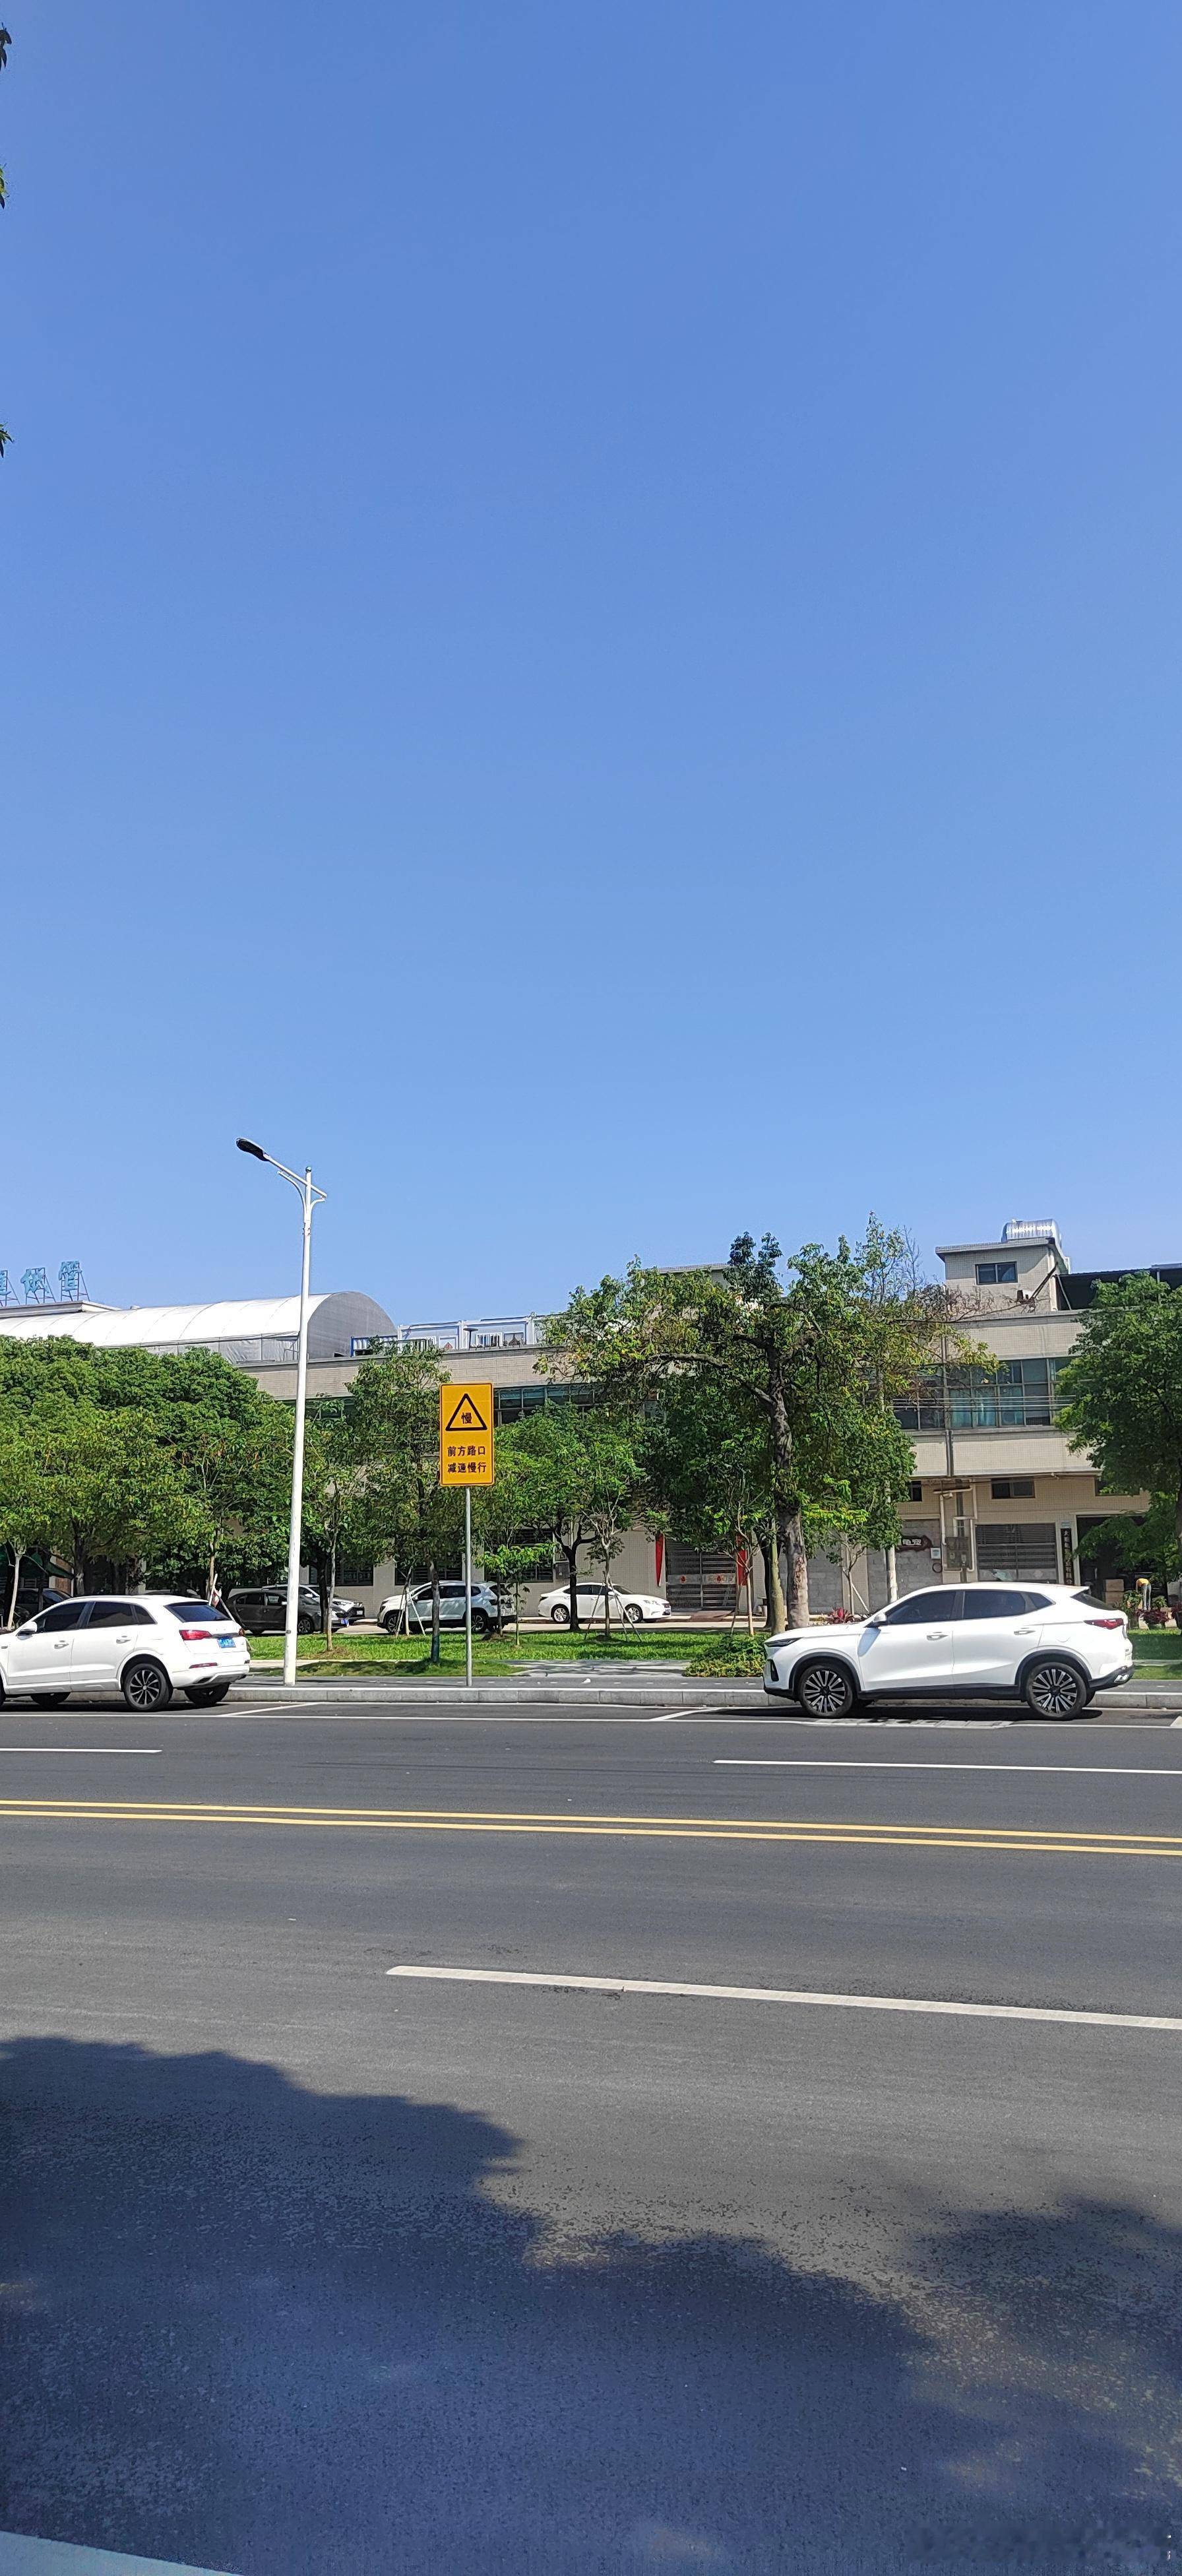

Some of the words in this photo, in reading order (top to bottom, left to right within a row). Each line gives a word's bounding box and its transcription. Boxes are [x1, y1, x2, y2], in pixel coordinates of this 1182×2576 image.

[461, 1412, 472, 1424] 慢
[447, 1446, 485, 1457] 前方路口
[448, 1462, 487, 1474] 减速慢行
